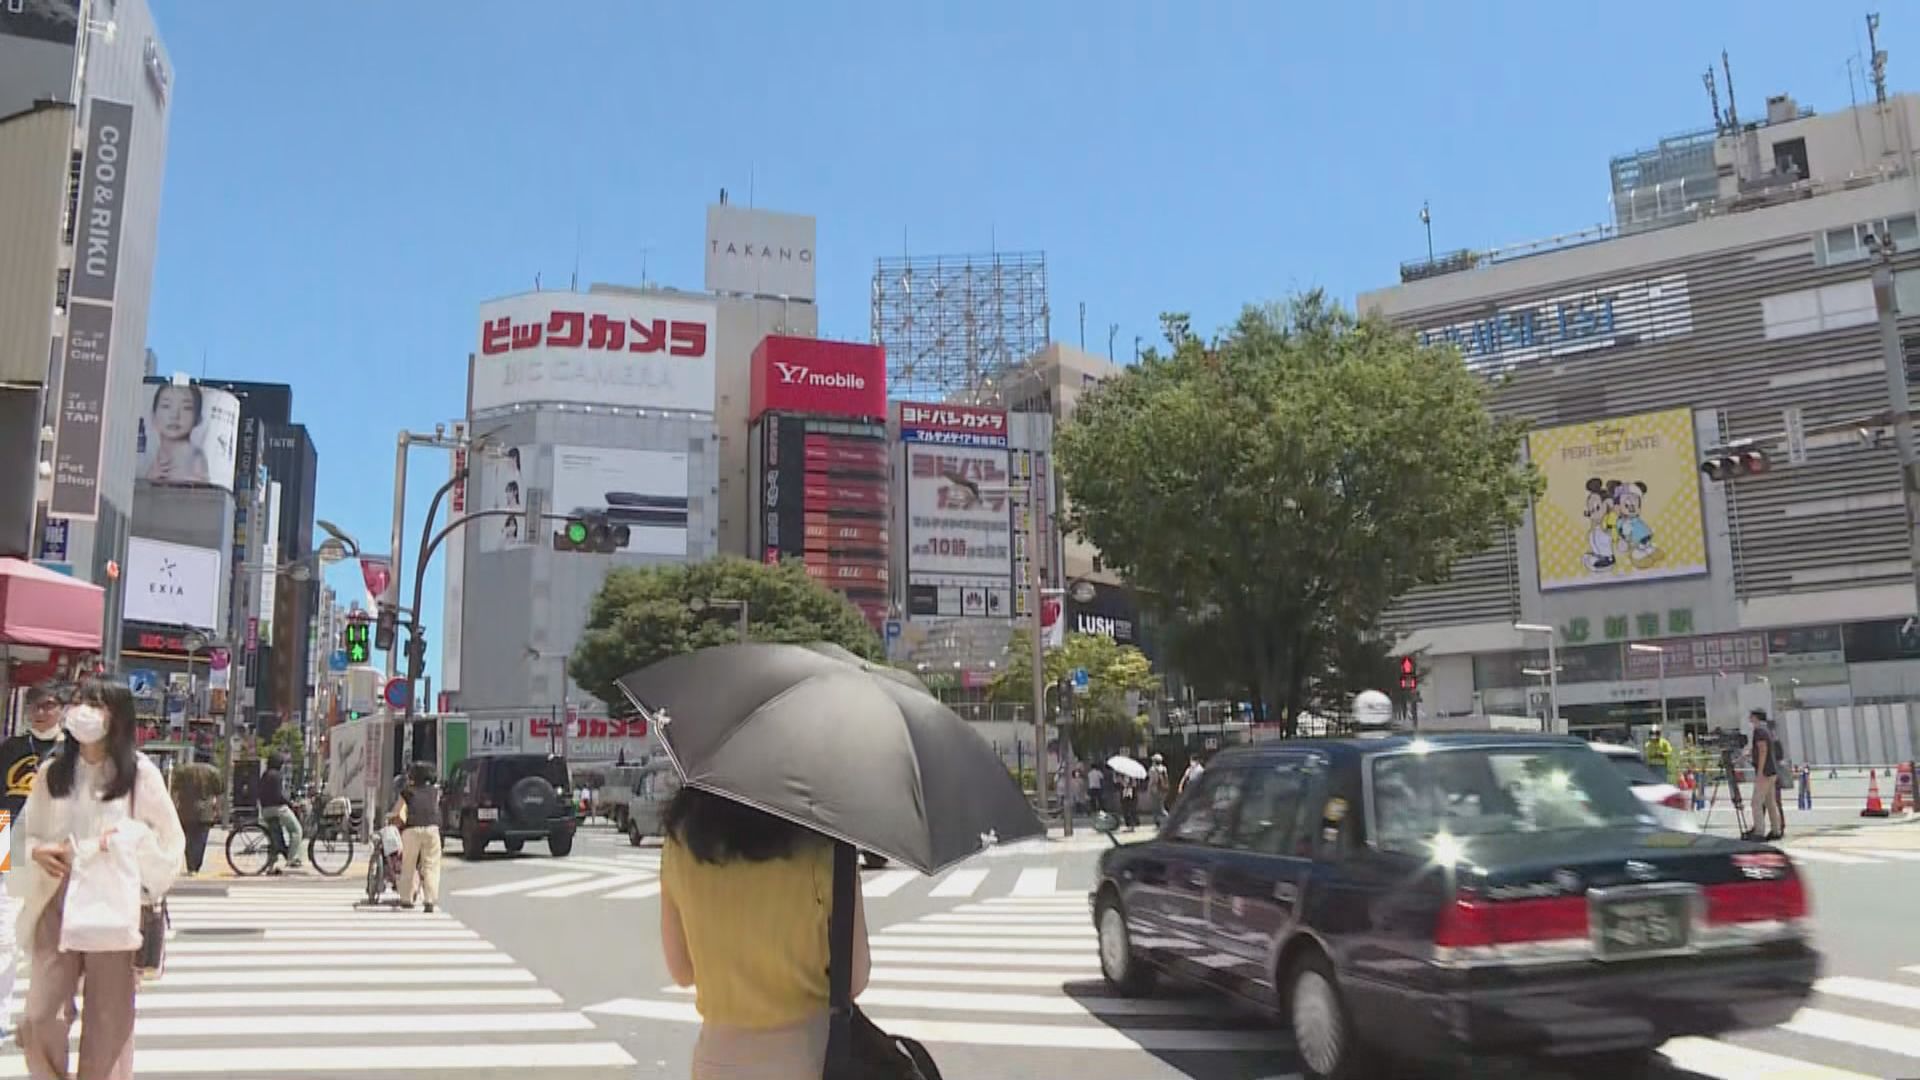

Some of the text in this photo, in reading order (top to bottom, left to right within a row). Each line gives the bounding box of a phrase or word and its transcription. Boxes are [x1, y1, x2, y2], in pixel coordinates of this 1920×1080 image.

[712, 240, 812, 262] TAKANO
[482, 311, 707, 357] ビックカメラ
[71, 350, 104, 362] Cafe
[903, 408, 1003, 429] ヨドバシカメラ
[150, 583, 184, 595] EXIA
[1078, 614, 1115, 638] LUSH
[530, 718, 647, 738] ビカメラ
